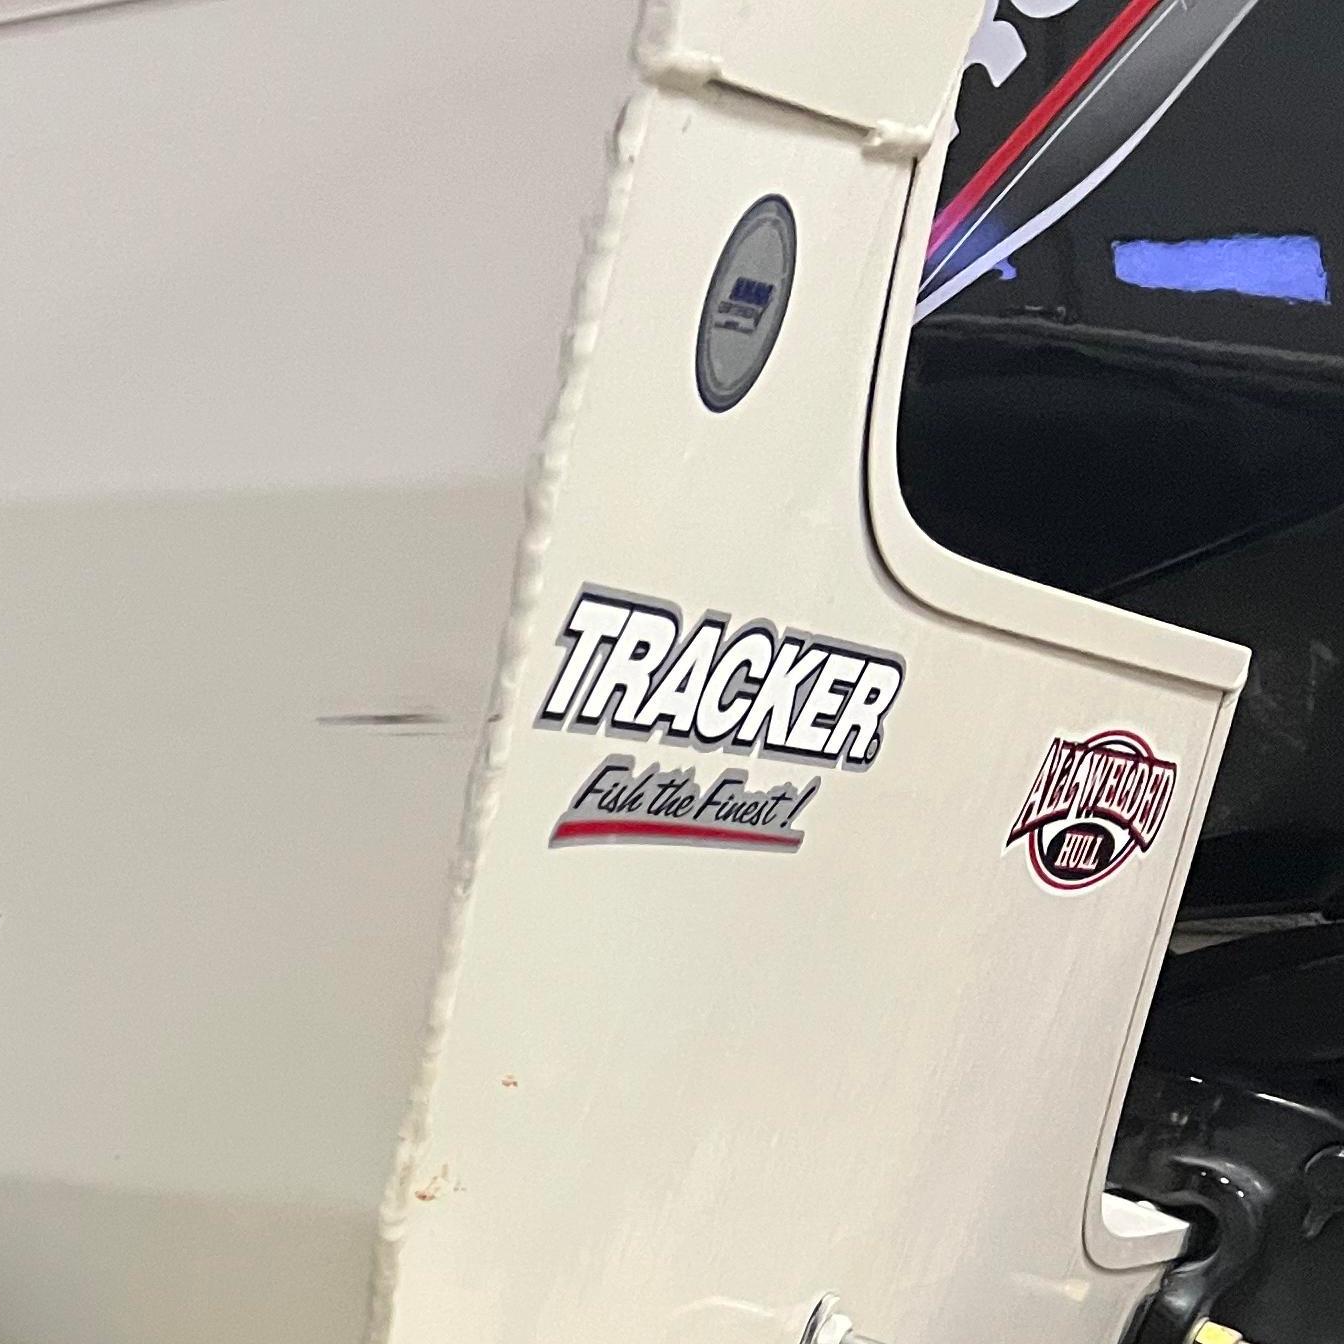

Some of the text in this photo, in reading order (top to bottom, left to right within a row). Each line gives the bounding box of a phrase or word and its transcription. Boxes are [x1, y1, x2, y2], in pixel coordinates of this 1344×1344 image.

[540, 592, 904, 764] TRACKER
[572, 765, 655, 813] Fish
[646, 777, 696, 818] the
[1053, 832, 1103, 870] HULL
